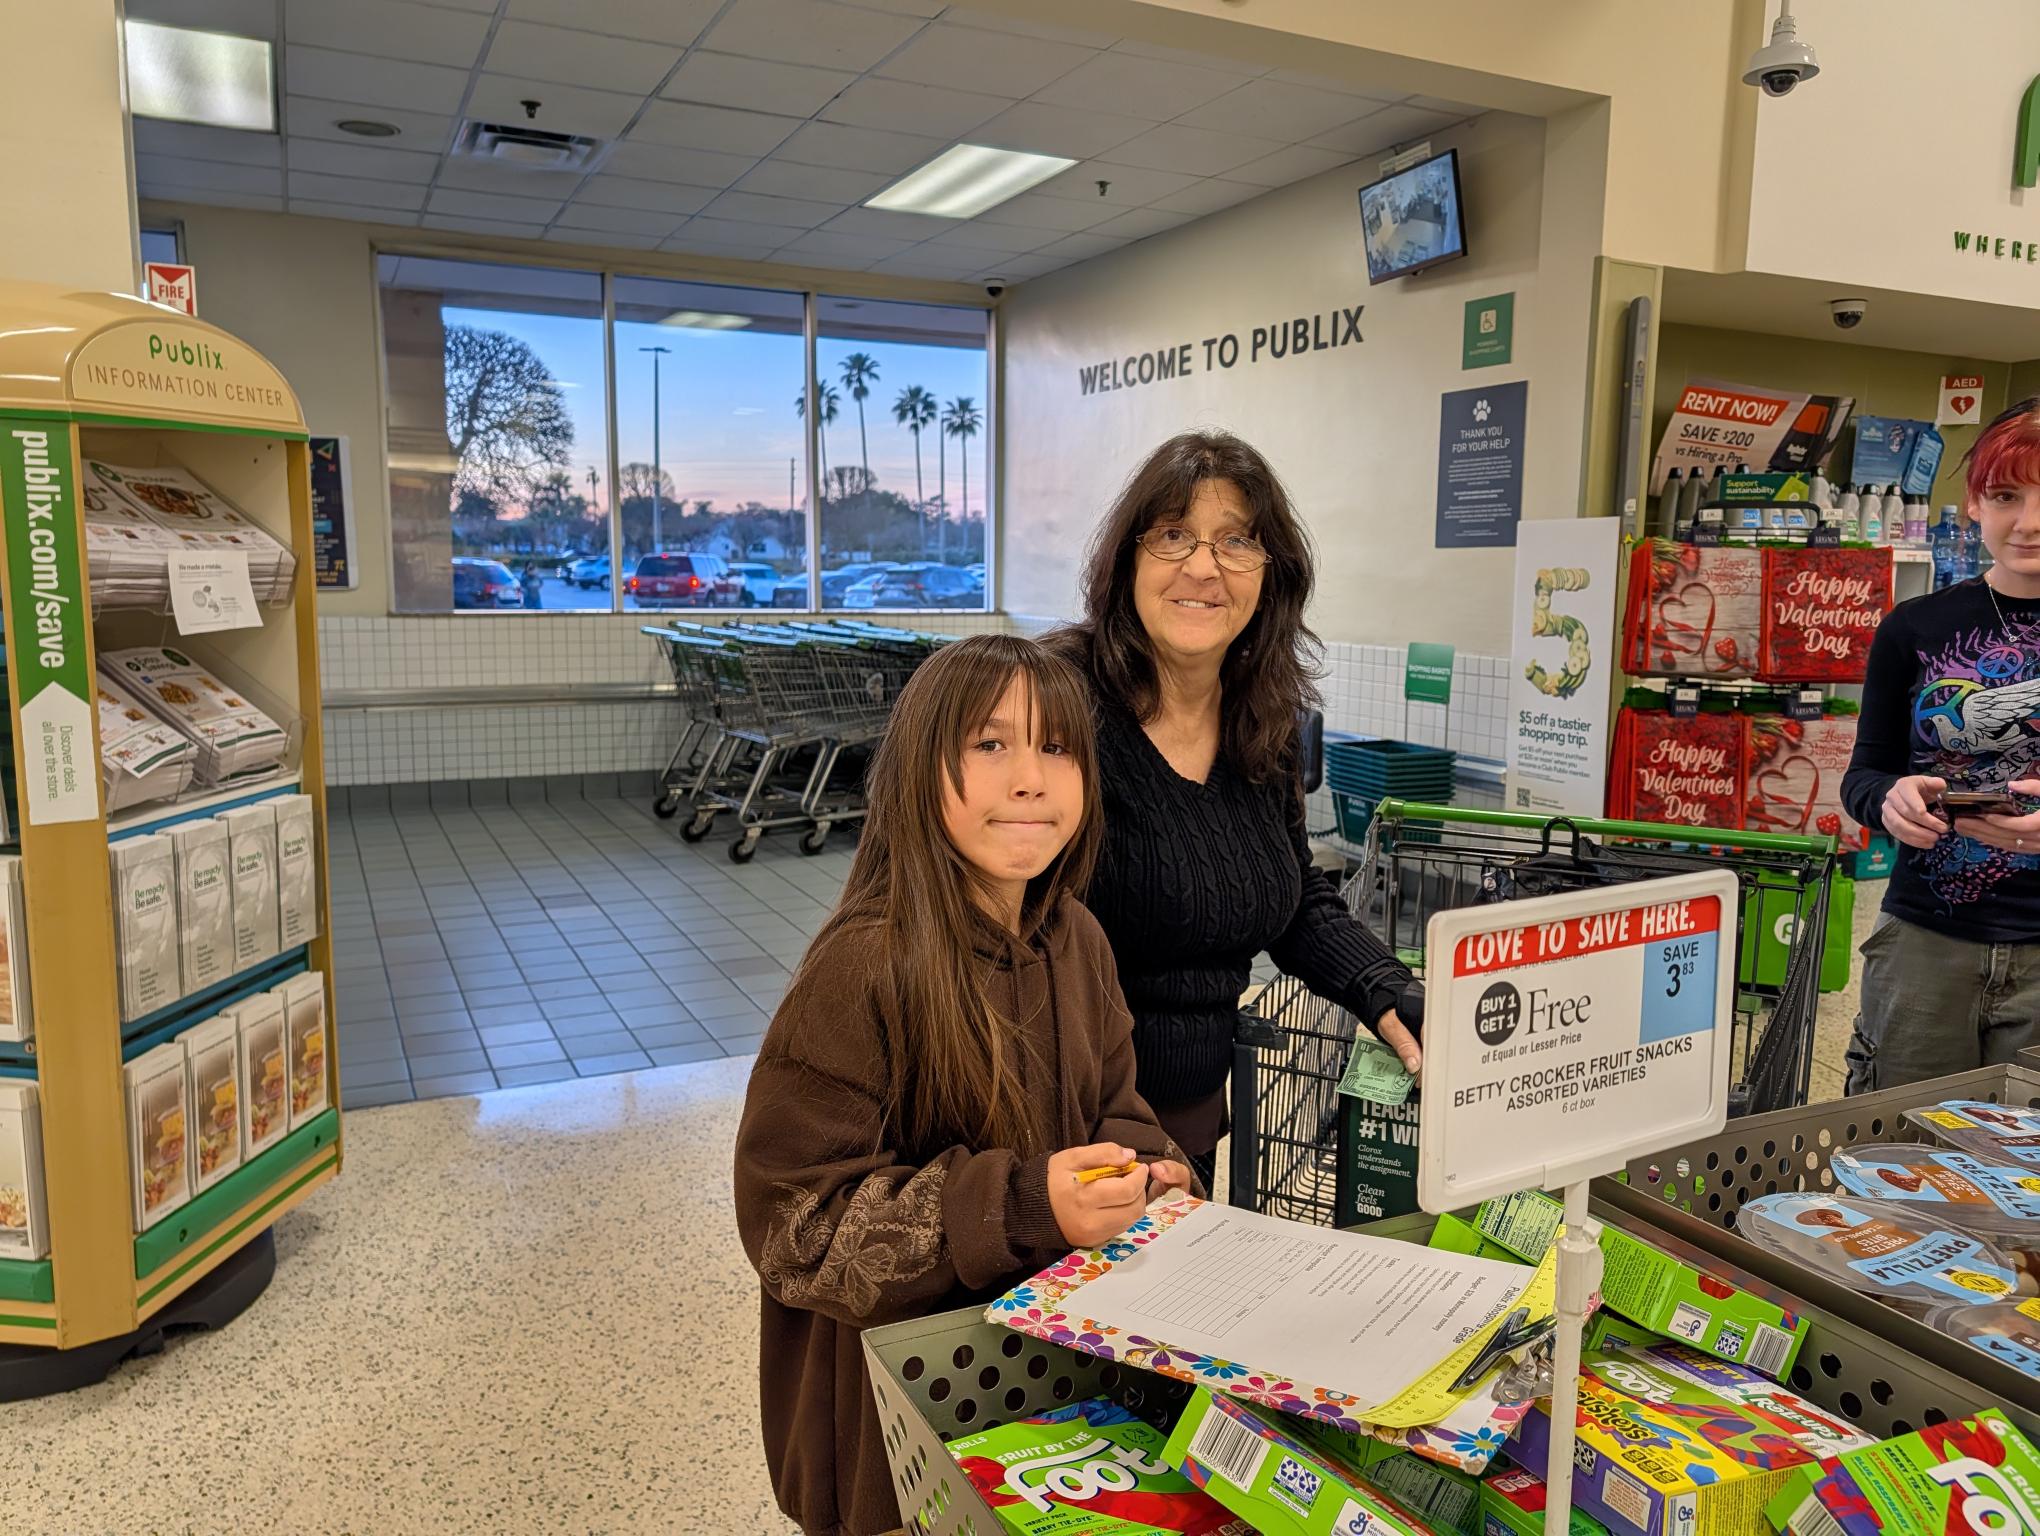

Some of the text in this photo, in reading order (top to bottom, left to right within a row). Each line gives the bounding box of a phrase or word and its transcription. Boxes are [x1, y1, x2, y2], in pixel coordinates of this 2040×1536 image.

[1954, 231, 2038, 262] WHERE
[158, 284, 185, 300] FIRE
[149, 334, 224, 370] Publix
[1080, 305, 1365, 396] WELCOME TO PUBLIX
[86, 364, 284, 406] INFORMATION CENTER
[1952, 378, 1978, 388] AED
[1682, 392, 1778, 422] RENT NOW!
[1460, 426, 1503, 440] THANK YOU
[1680, 423, 1755, 447] SAVE $200
[1452, 438, 1511, 454] FOR YOUR HELP
[1675, 446, 1744, 464] vs Hiring a Pro
[1726, 480, 1758, 489] Support
[12, 430, 70, 669] publix.com/save
[1787, 571, 1872, 606] Happy
[1775, 602, 1882, 628] Valentines
[1804, 628, 1850, 660] Day
[42, 720, 53, 738] all
[1519, 709, 1592, 733] $5 off a tastier
[1518, 724, 1588, 749] shopping trip.
[44, 738, 55, 760] over
[59, 725, 75, 793] Discover deals
[1650, 738, 1727, 773] Happy
[46, 760, 56, 776] the
[1639, 768, 1734, 795] Valentines
[1664, 796, 1706, 826] Day
[1465, 928, 1523, 970] LOVE
[1538, 921, 1566, 954] TO
[1578, 910, 1631, 948] SAVE
[1641, 900, 1696, 938] HERE.
[1662, 941, 1700, 962] SAVE
[1666, 962, 1695, 998] 3 83
[1480, 993, 1517, 1014] BUY 1
[1525, 988, 1592, 1036] Free
[1480, 1012, 1516, 1034] GET 1
[1482, 1032, 1582, 1064] of Equal or Lesser Price
[1454, 1036, 1694, 1108] BETTY CROCKER FRUIT SNACKS
[1506, 1066, 1646, 1112] ASSORTED VARIETIES
[1562, 1096, 1596, 1114] 6 ct box
[1358, 1118, 1388, 1142] #1
[1358, 1144, 1382, 1155] Clorox
[1358, 1154, 1402, 1168] understands
[1358, 1161, 1412, 1178] the assignment.
[1357, 1183, 1385, 1198] Clean
[1946, 1156, 2040, 1217] PRETZILLA
[1355, 1194, 1378, 1206] feels
[1356, 1202, 1382, 1218] GOOD
[1480, 1200, 1496, 1230] Nutrition
[1500, 1215, 1513, 1241] Calories
[1857, 1234, 1888, 1246] BITES
[1862, 1237, 1908, 1254] PRETZEL
[1867, 1238, 1972, 1280] PRETZILLA
[1501, 1286, 1520, 1305] Publix
[1452, 1326, 1474, 1344] Grade
[1986, 1416, 2007, 1436] 6
[954, 1436, 988, 1451] ROLLS
[996, 1431, 1093, 1465] FRUIT BY THE
[1870, 1451, 1914, 1505] STRAWBERRY
[1884, 1447, 1936, 1512] BERRY TIE-DYE
[1894, 1444, 1934, 1491] VARIETY PACK
[1854, 1455, 1910, 1530] BLUE RASPBERRY
[1024, 1512, 1068, 1527] VARIETY PACK
[1032, 1522, 1057, 1534] BERRY
